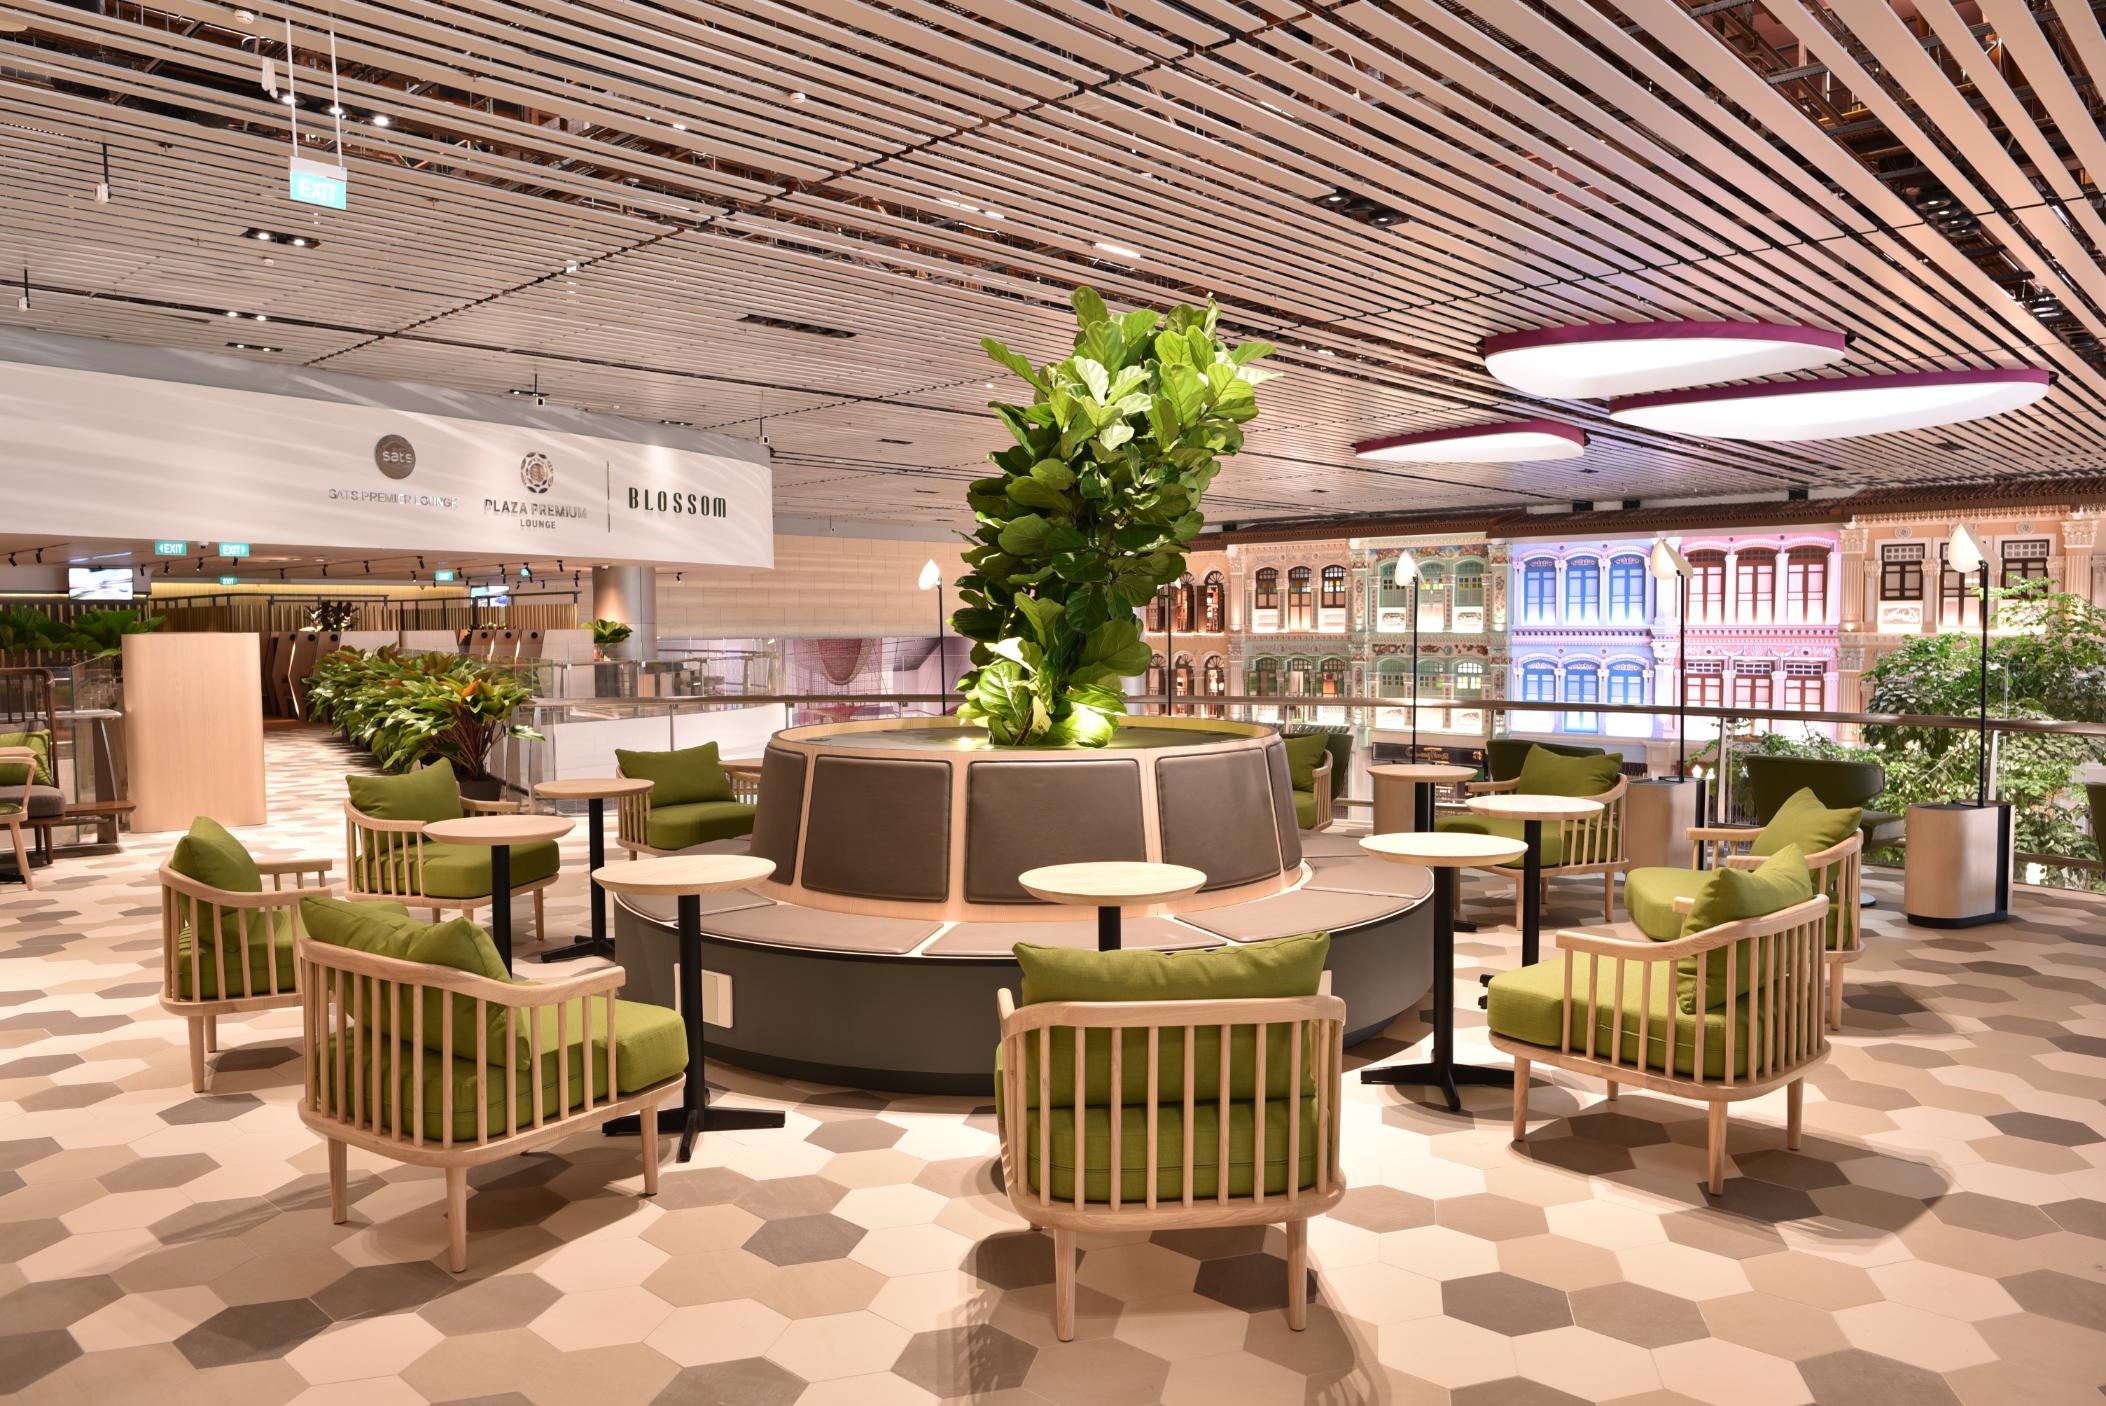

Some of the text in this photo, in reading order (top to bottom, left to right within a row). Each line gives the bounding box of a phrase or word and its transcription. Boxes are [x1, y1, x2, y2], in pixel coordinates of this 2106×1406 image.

[298, 177, 338, 202] EXIT
[382, 451, 413, 464] sats
[328, 488, 359, 501] SATS
[484, 498, 588, 519] PLAZA PREMIUM
[628, 487, 727, 518] BLOSSOM
[520, 519, 556, 529] LOUNGE
[164, 543, 183, 554] EXIT
[222, 545, 241, 555] EXIT
